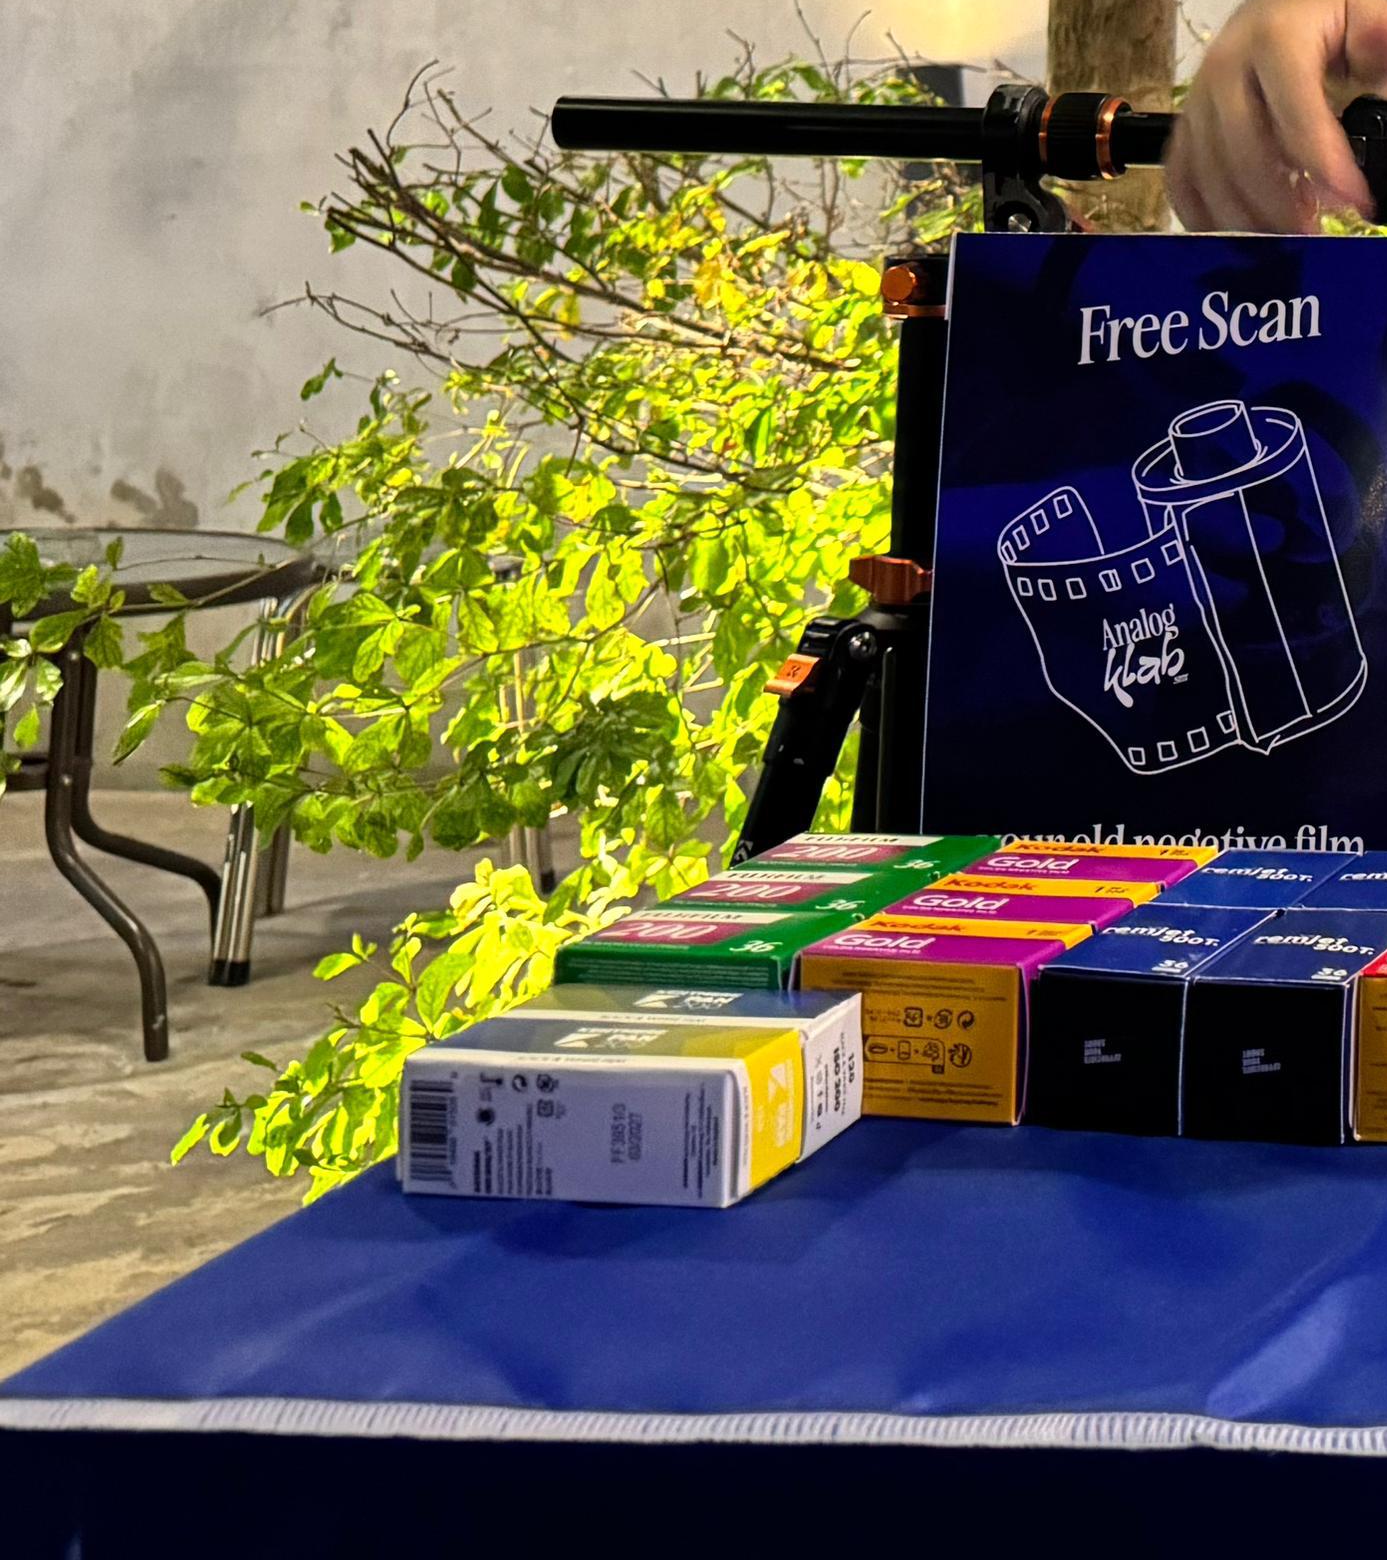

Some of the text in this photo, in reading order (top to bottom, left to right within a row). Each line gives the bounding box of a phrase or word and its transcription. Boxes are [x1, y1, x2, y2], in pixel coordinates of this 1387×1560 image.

[1077, 291, 1322, 365] Free Scan
[1102, 602, 1179, 651] Analog
[1295, 825, 1364, 856] film
[771, 845, 881, 859] 200
[893, 859, 941, 870] 36
[986, 856, 1080, 870] Gold
[689, 883, 801, 899] 200
[943, 878, 1036, 891] Kodak
[815, 899, 866, 910] 36
[912, 894, 1010, 910] Gold
[598, 924, 718, 940] 200
[869, 920, 968, 933] Kodak
[729, 940, 783, 953] 36
[833, 932, 936, 949] Gold
